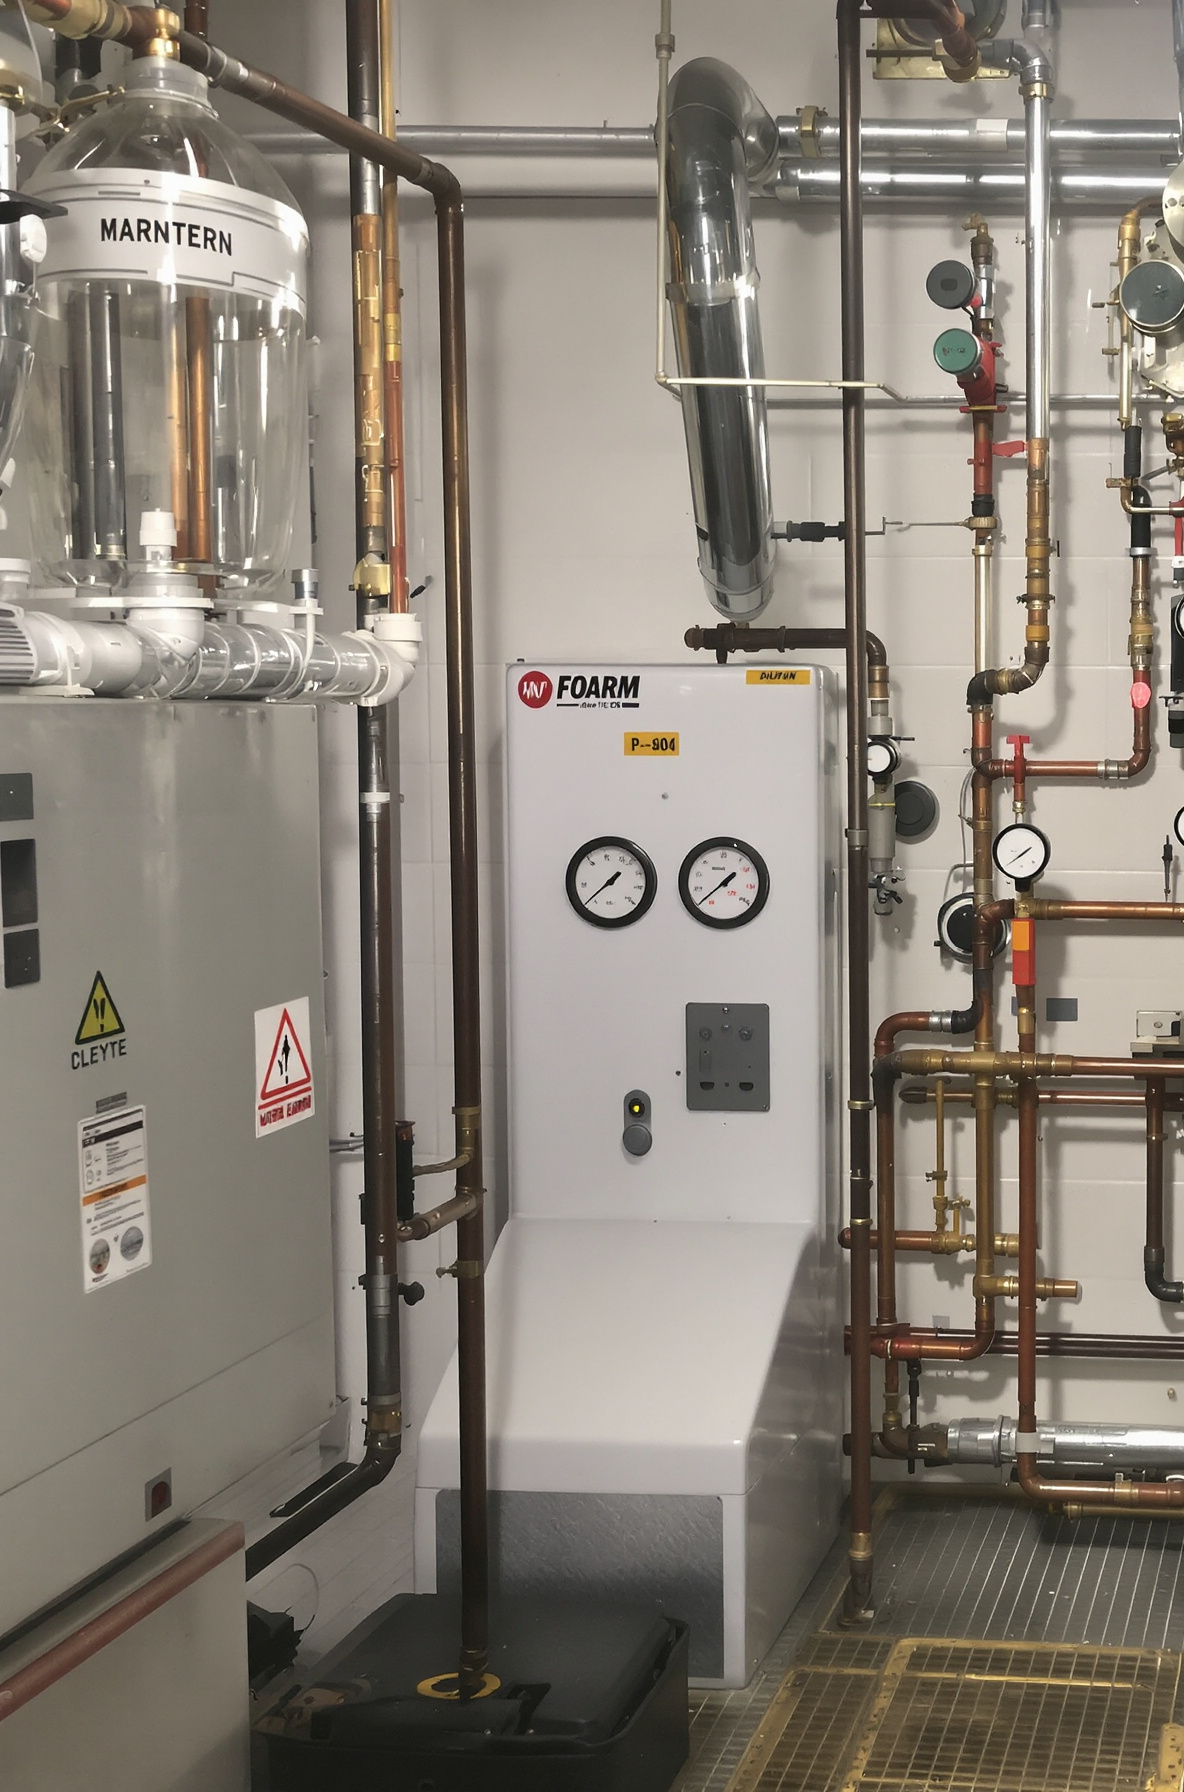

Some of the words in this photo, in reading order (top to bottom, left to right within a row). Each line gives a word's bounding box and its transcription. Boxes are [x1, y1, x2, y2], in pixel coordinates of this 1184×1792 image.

[101, 218, 232, 257] MARNTERN
[557, 675, 641, 699] FOARM
[71, 1038, 127, 1070] CLEYTE
